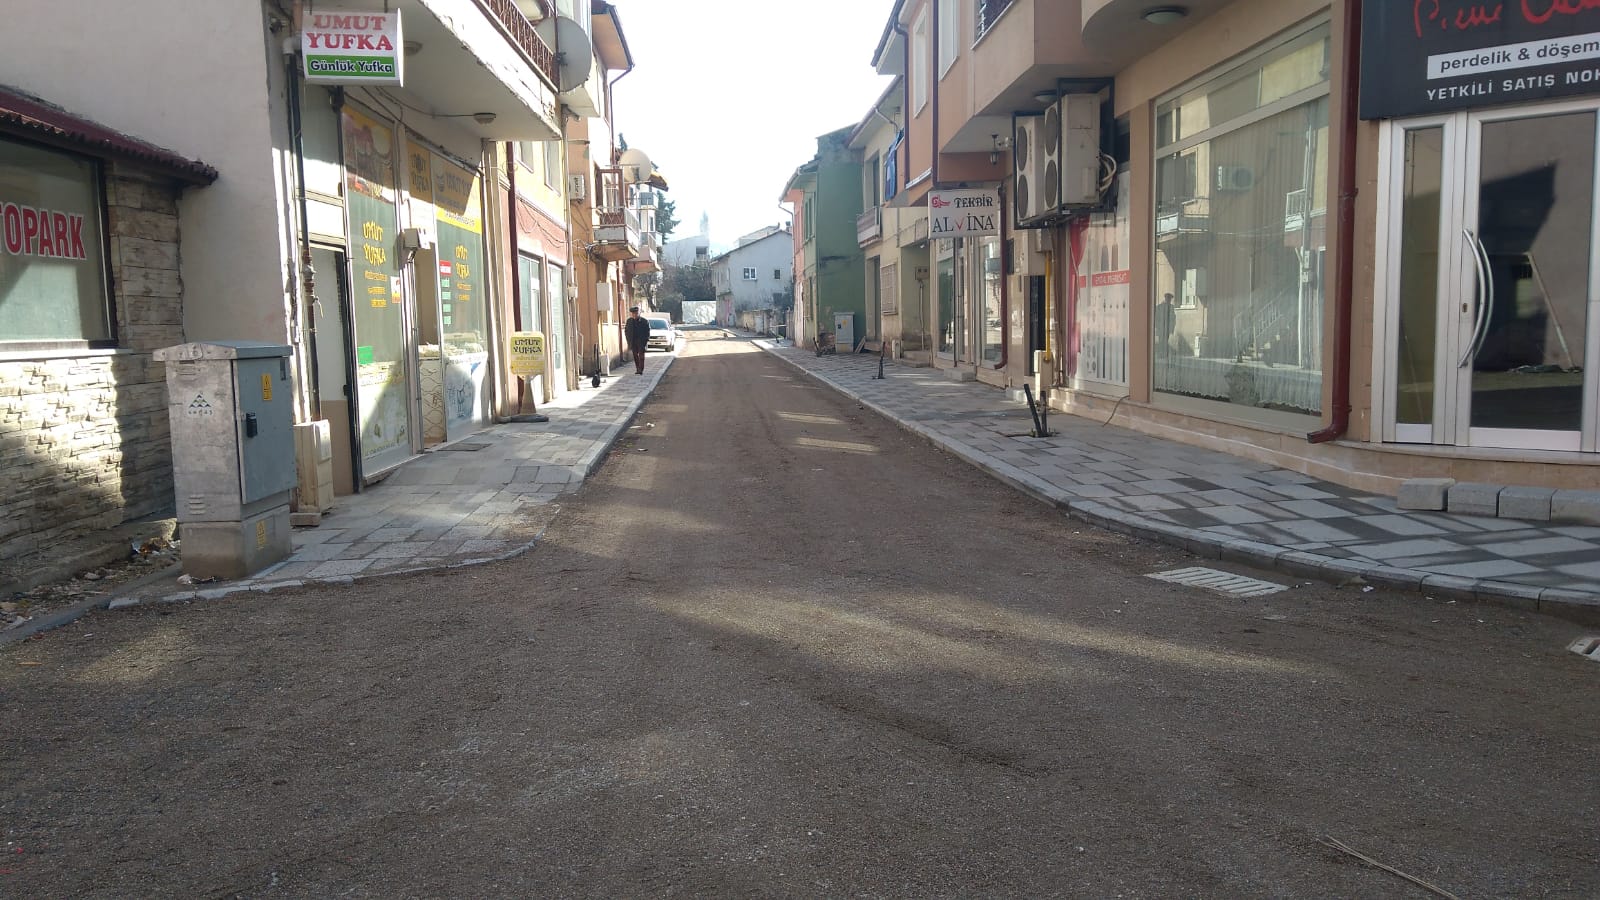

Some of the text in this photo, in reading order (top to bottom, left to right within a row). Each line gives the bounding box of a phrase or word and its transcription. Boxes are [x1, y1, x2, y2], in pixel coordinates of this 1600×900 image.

[314, 14, 386, 31] UMUT
[306, 32, 394, 51] YUFKA
[310, 60, 392, 74] Günlük Yufka
[1440, 50, 1512, 74] perdelik
[1517, 48, 1531, 61] &
[1426, 79, 1493, 102] YETKİLİ
[953, 194, 994, 209] TEKBİR
[0, 202, 87, 261] OPARK
[932, 212, 995, 233] ALVİNA
